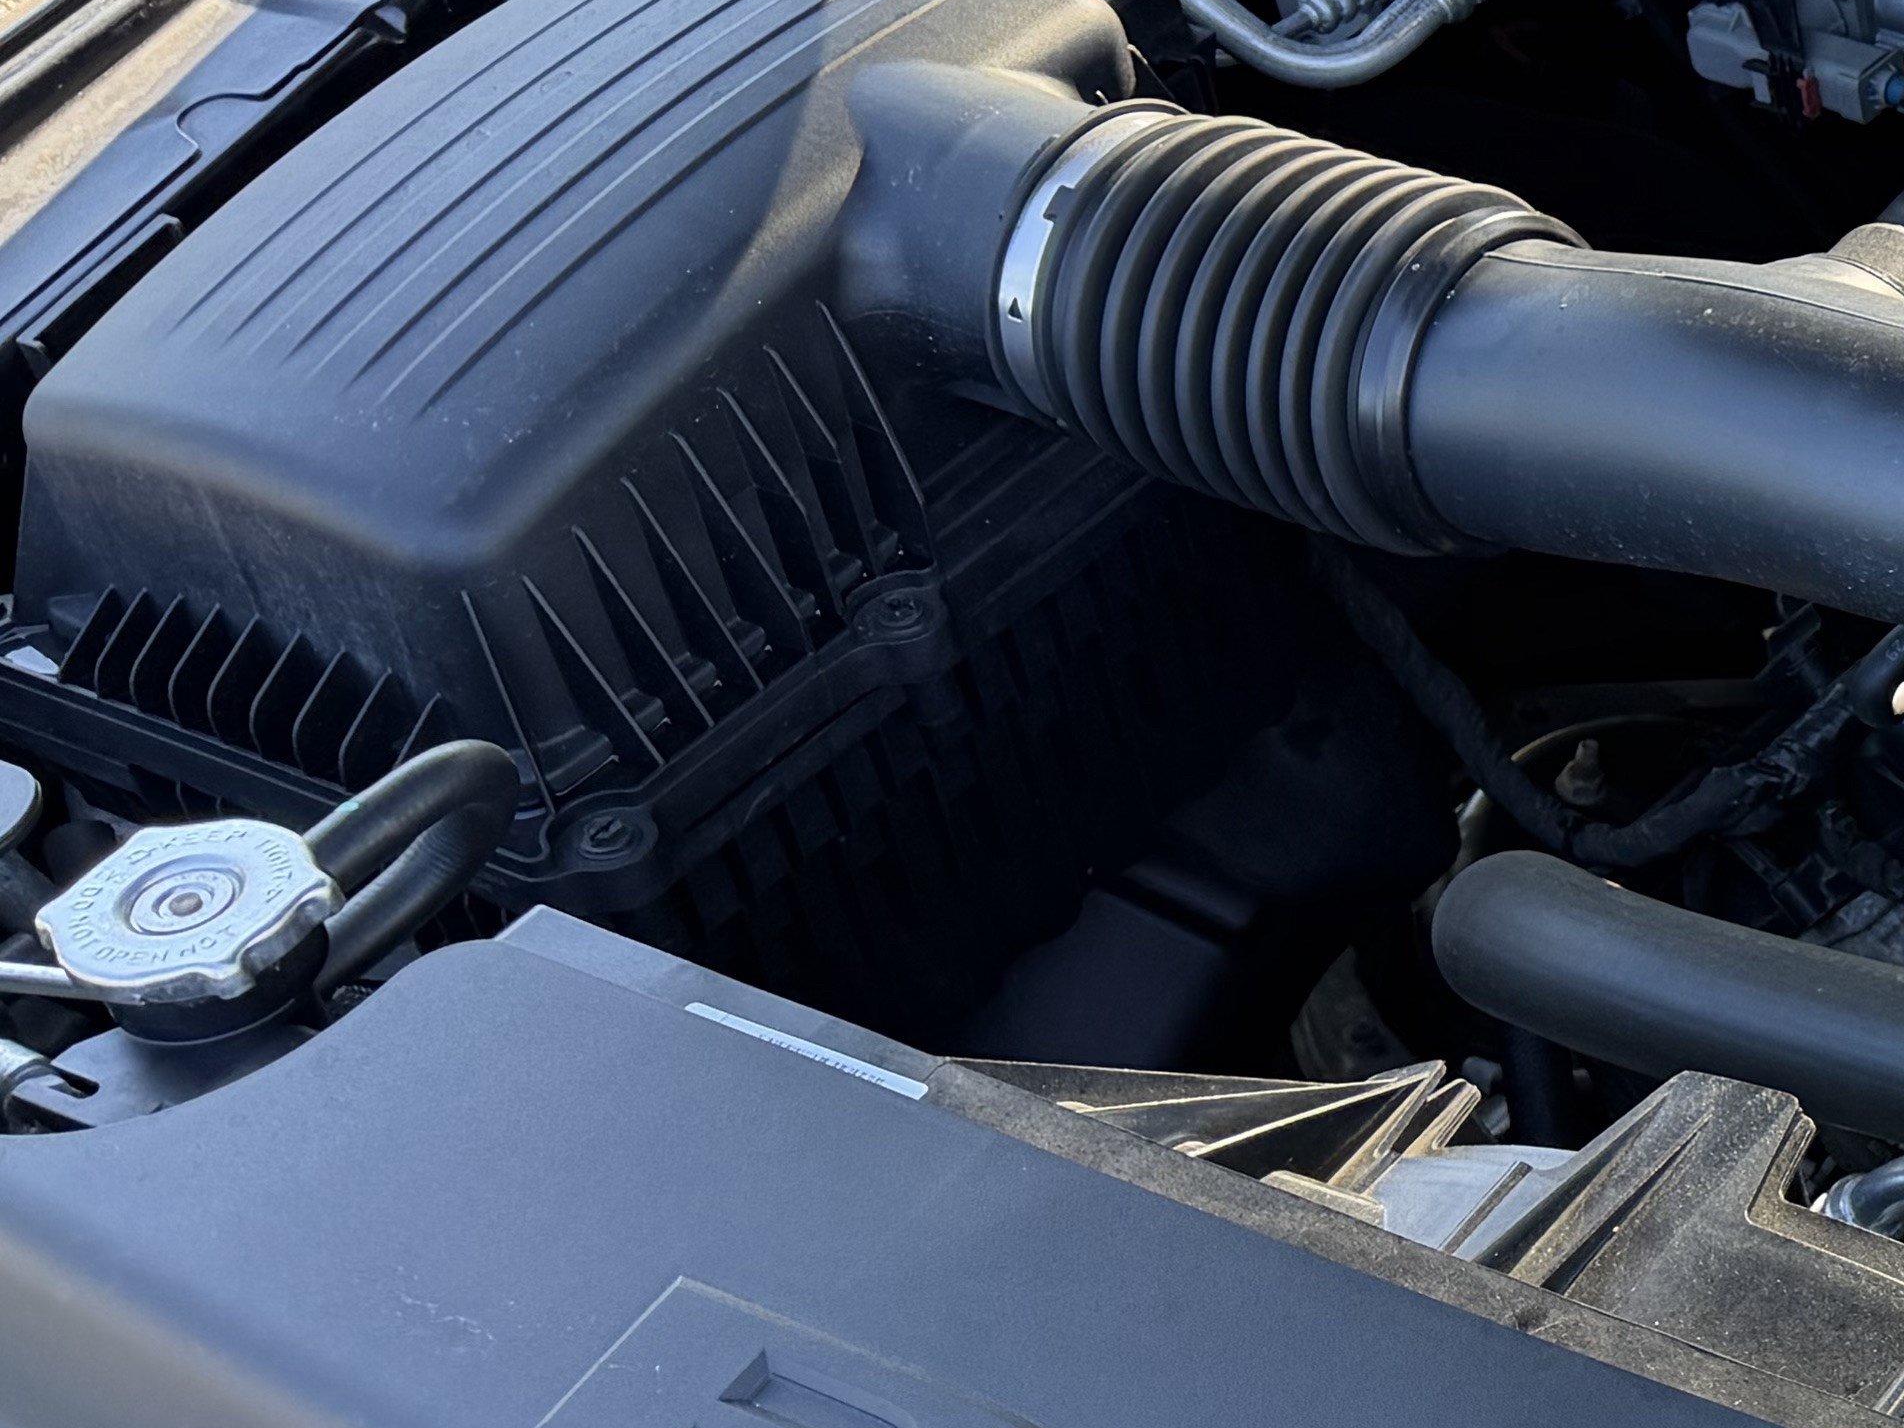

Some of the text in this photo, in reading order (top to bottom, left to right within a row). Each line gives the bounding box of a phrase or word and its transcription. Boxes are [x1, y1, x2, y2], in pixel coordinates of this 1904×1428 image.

[162, 830, 248, 850] KEEP
[94, 946, 169, 964] OPEN
[179, 924, 238, 958] HOT
